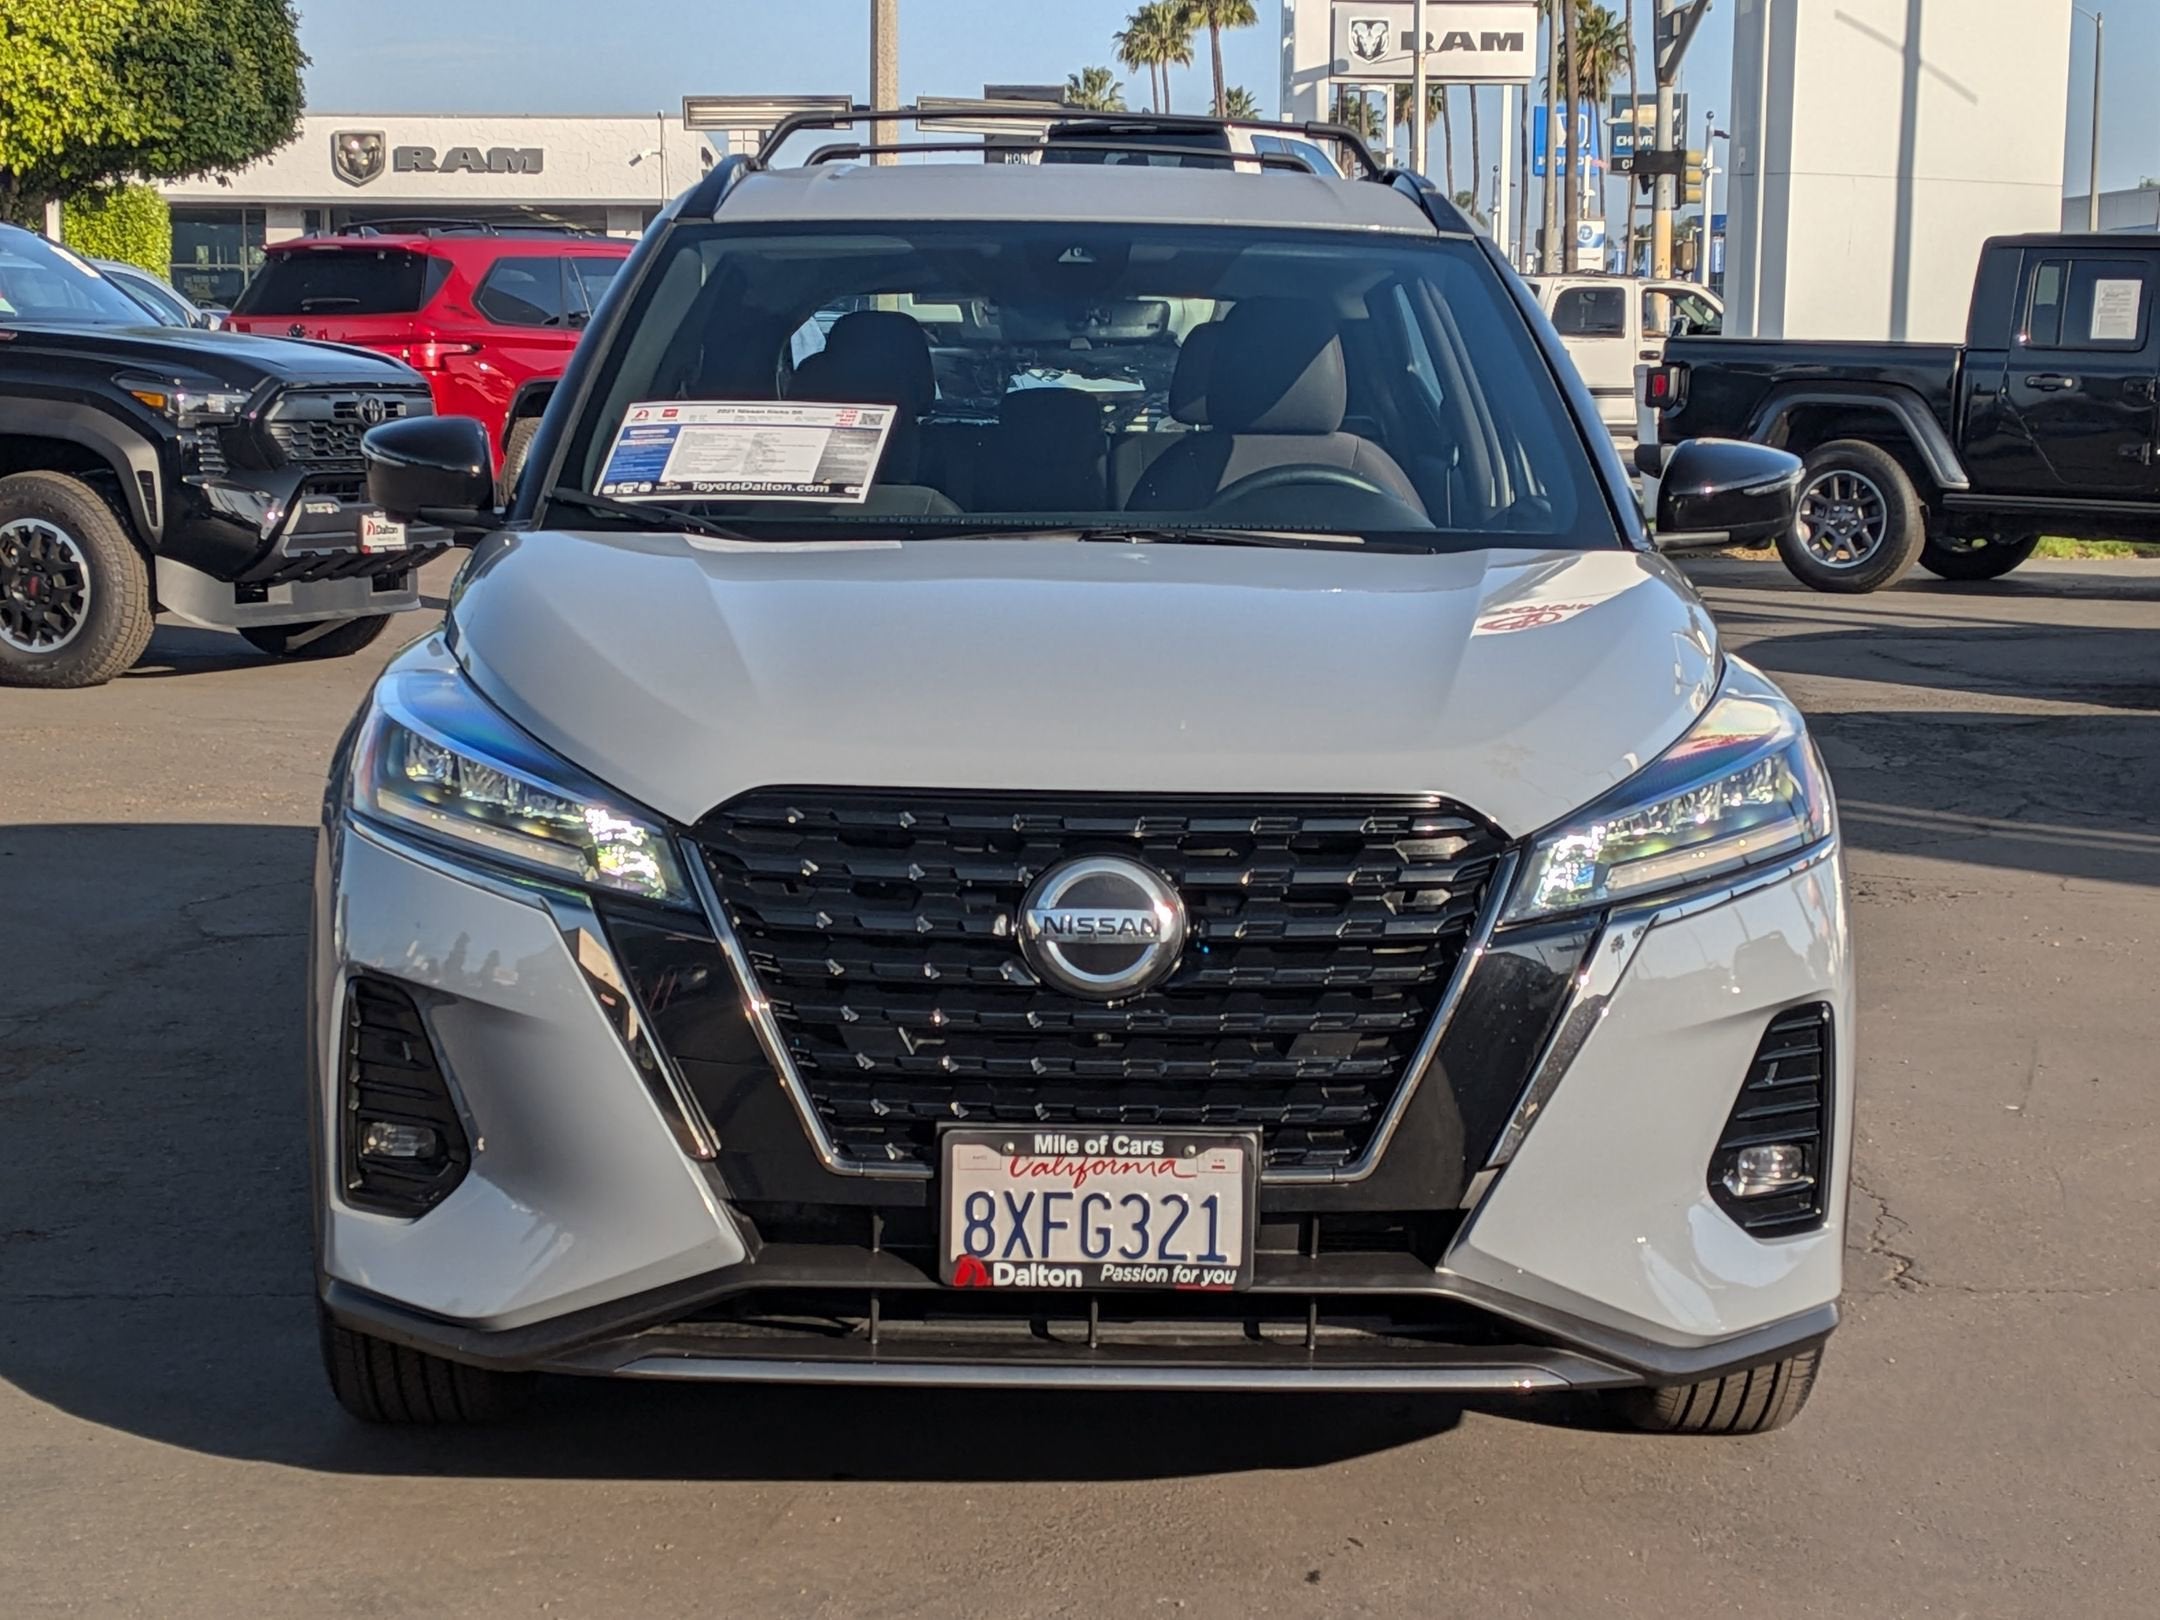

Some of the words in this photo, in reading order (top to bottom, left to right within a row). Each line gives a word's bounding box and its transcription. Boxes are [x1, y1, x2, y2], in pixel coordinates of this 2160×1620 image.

[1401, 31, 1524, 51] RAM
[393, 146, 543, 173] RAM
[692, 481, 830, 493] ToyotaDalton.com
[1043, 916, 1161, 936] NISSAN
[1034, 1134, 1080, 1154] Mile
[1084, 1135, 1109, 1154] of
[1112, 1135, 1165, 1155] Cars
[1010, 1155, 1197, 1188] California
[964, 1190, 1228, 1263] 8XFG321
[993, 1262, 1083, 1287] Dalton
[1100, 1263, 1168, 1283] Passion
[1172, 1264, 1200, 1283] for
[1200, 1268, 1237, 1287] you
